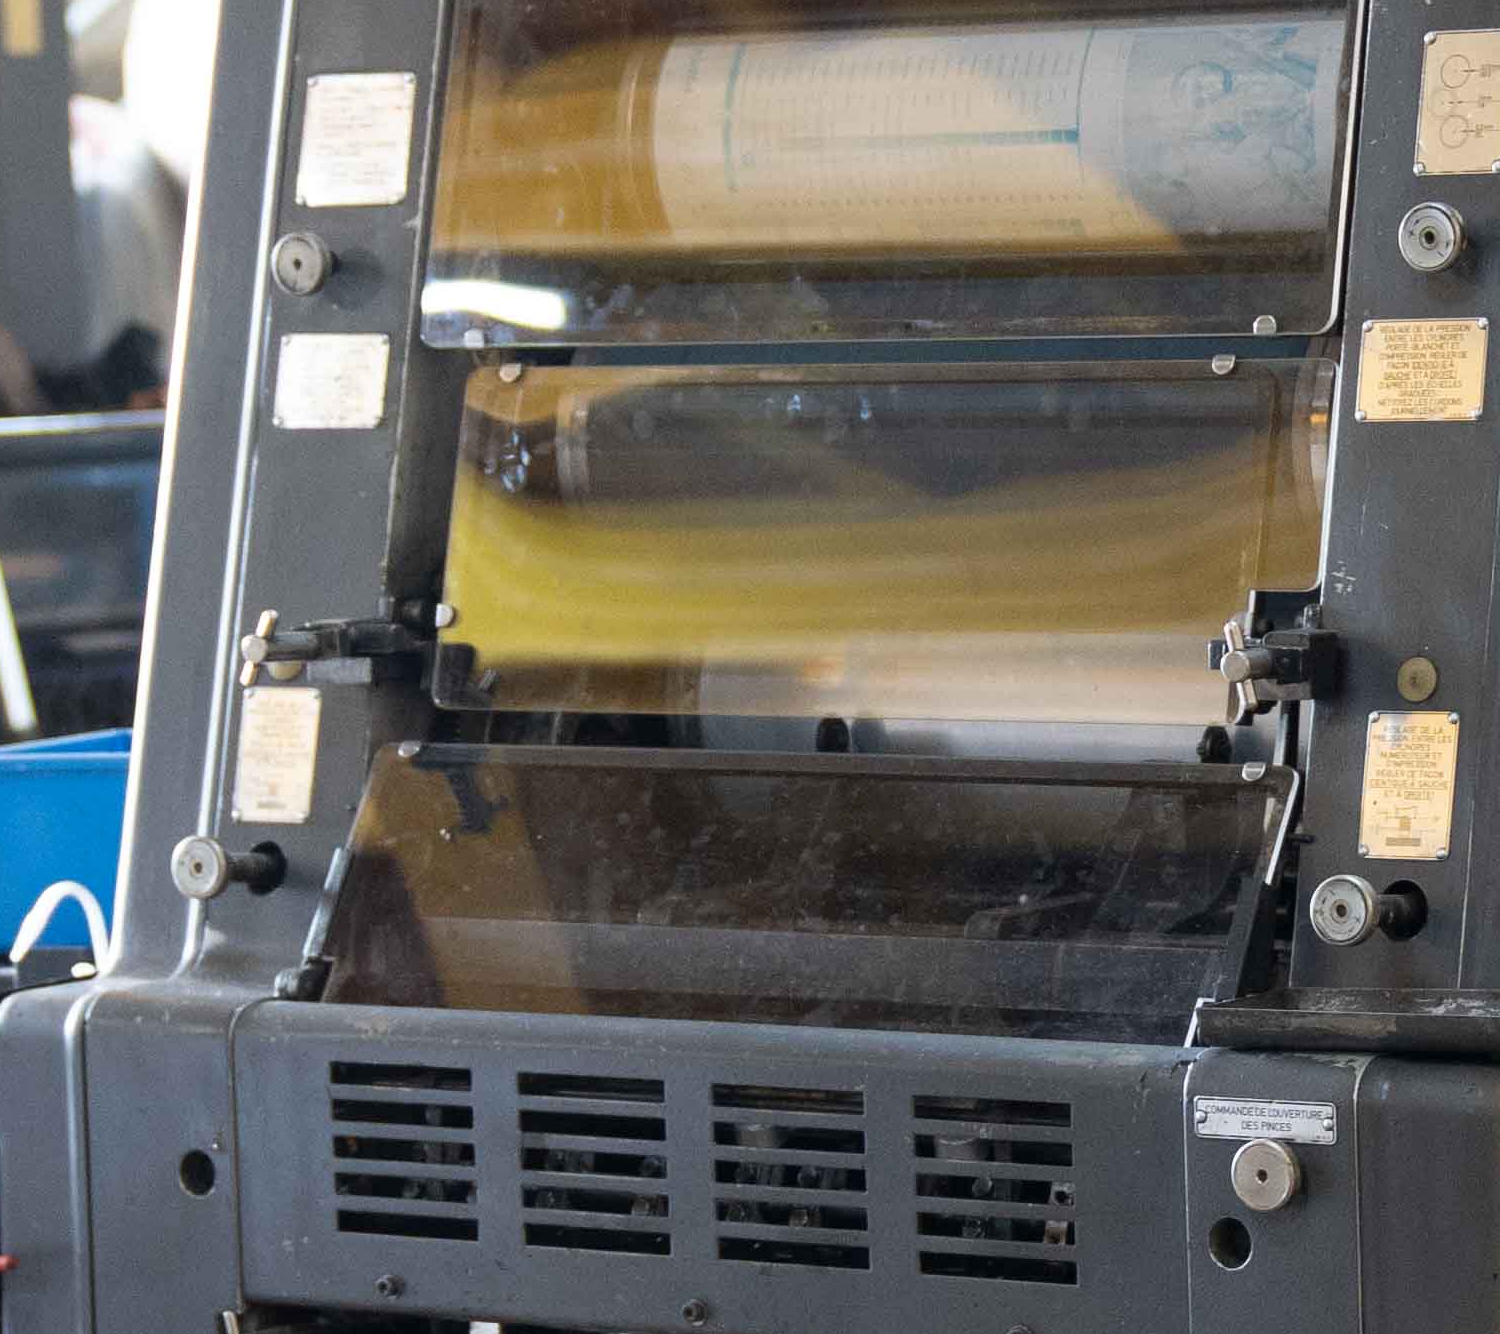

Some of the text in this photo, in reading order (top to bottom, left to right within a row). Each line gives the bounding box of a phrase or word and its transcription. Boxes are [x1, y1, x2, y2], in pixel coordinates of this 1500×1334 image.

[1206, 1105, 1253, 1116] COMMANDE
[1241, 1121, 1292, 1132] DES PINCES
